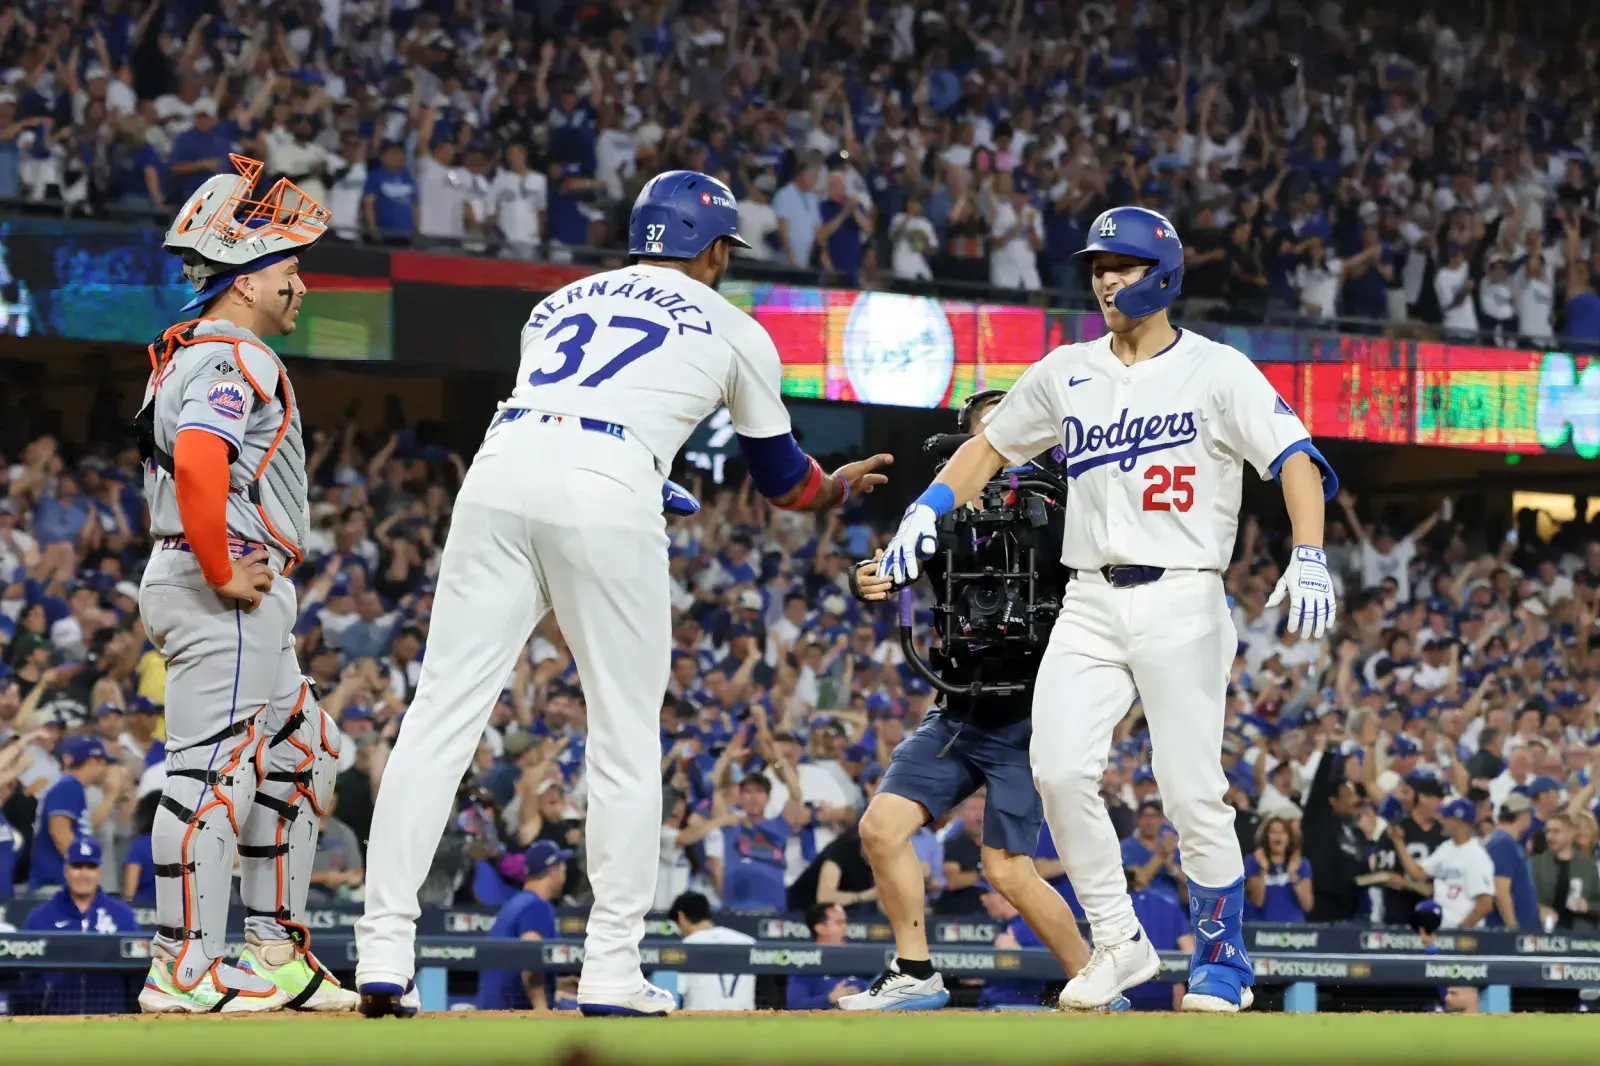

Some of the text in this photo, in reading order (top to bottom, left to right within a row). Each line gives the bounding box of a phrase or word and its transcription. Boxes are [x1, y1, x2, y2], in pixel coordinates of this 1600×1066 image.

[646, 224, 666, 241] 37
[1099, 213, 1117, 237] LA
[528, 278, 713, 336] HERNÁNDEZ
[528, 312, 671, 388] 37
[1062, 408, 1198, 473] Dodgers
[1142, 465, 1196, 512] 25
